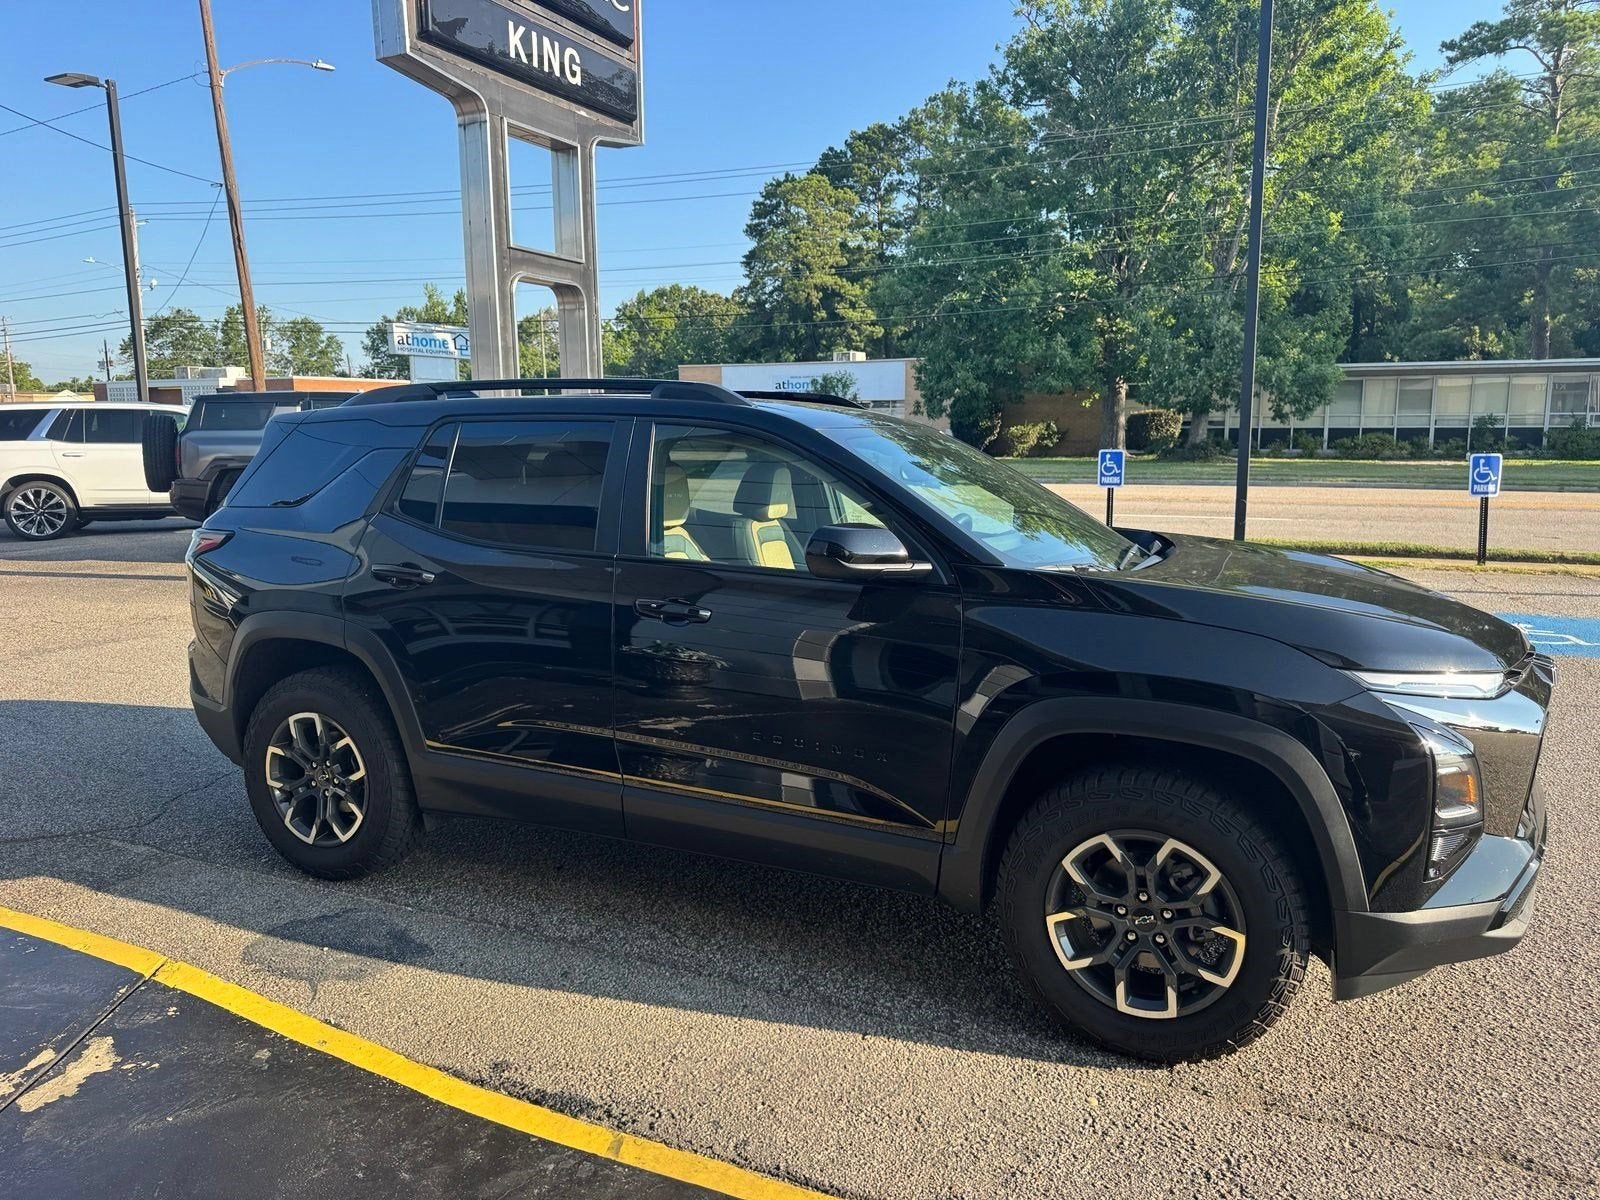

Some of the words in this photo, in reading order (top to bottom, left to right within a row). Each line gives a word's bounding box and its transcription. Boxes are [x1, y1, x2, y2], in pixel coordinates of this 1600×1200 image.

[508, 20, 582, 87] KING
[397, 332, 450, 350] athome
[1101, 476, 1121, 484] PARKING
[1473, 484, 1496, 493] PARKING
